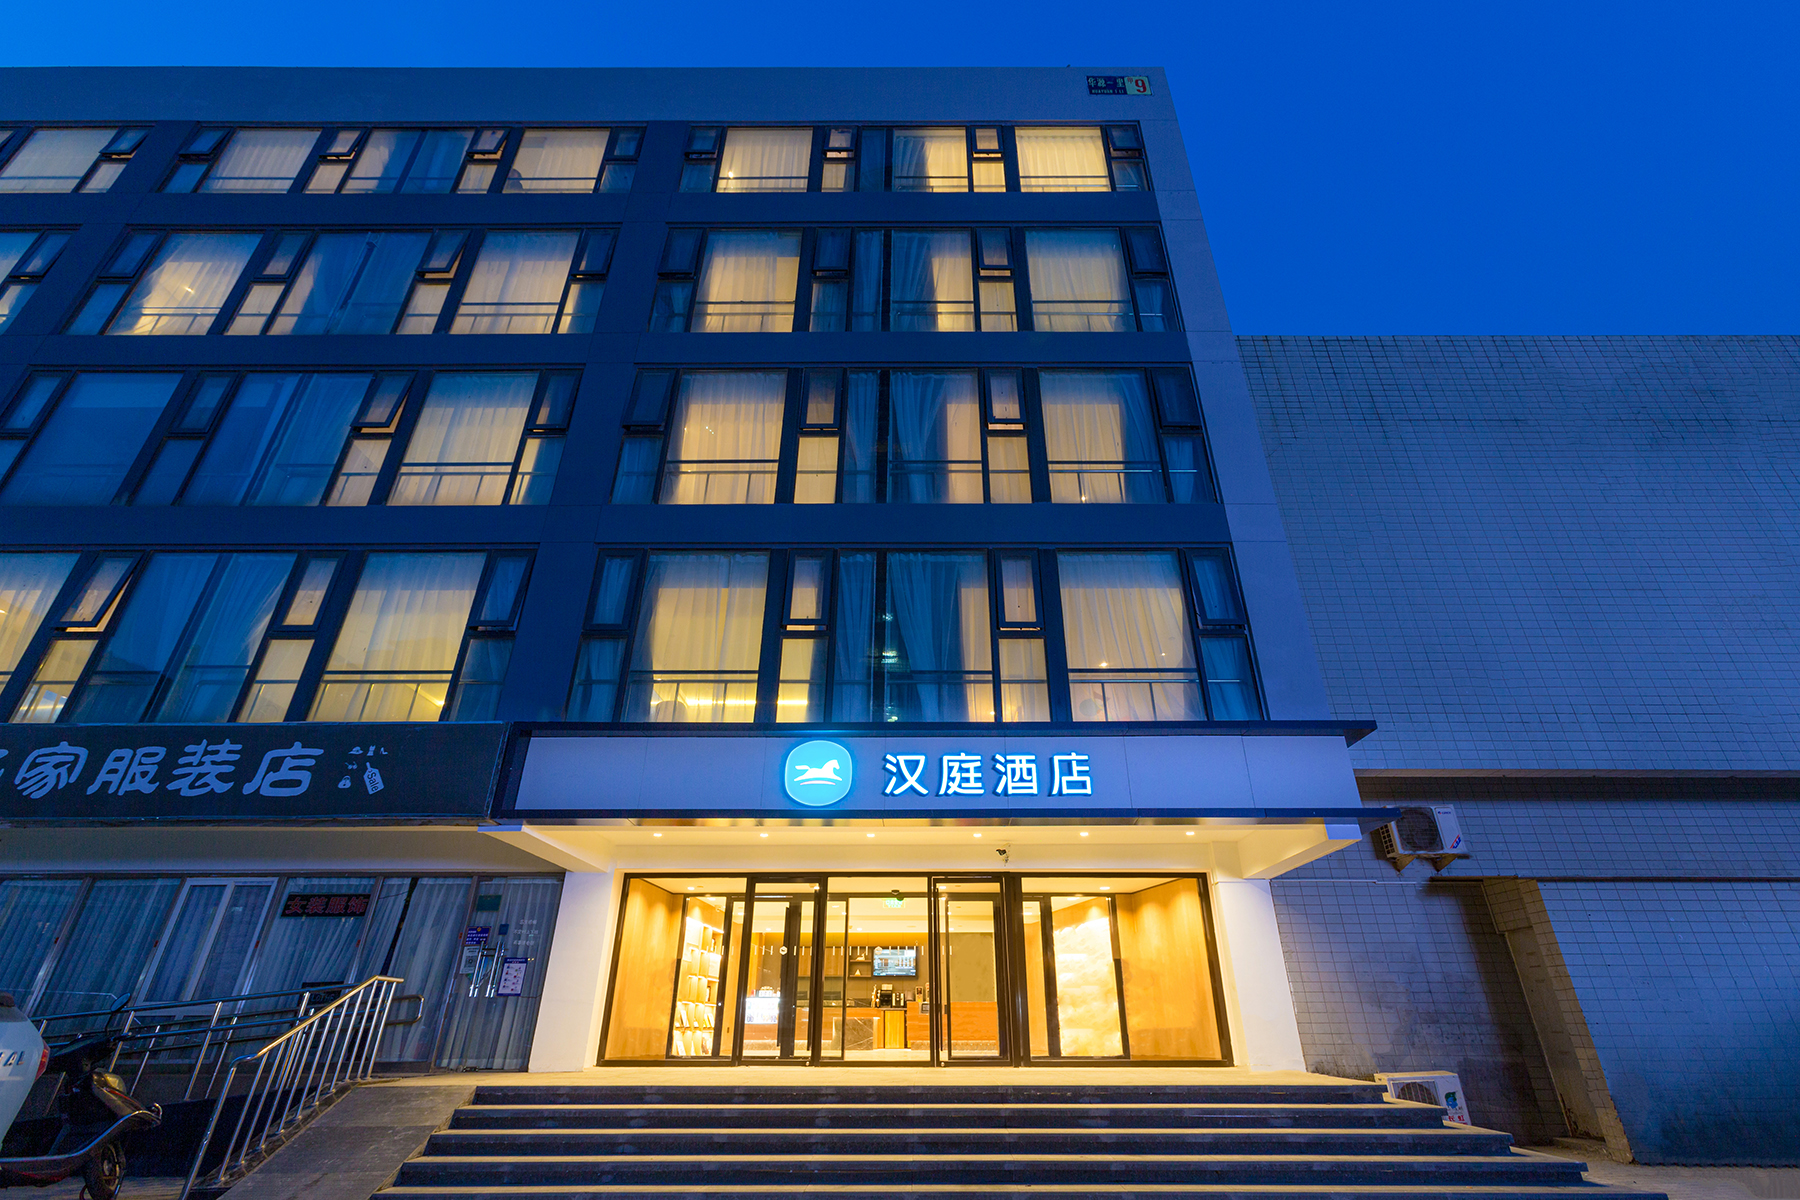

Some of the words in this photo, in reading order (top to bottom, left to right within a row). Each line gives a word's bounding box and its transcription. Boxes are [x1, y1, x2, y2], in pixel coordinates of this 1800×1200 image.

[1135, 78, 1147, 93] 9
[0, 738, 324, 799] 家服装店
[885, 752, 1092, 796] 汉庭酒店
[367, 771, 380, 792] Sale
[285, 896, 369, 914] 女装服饰
